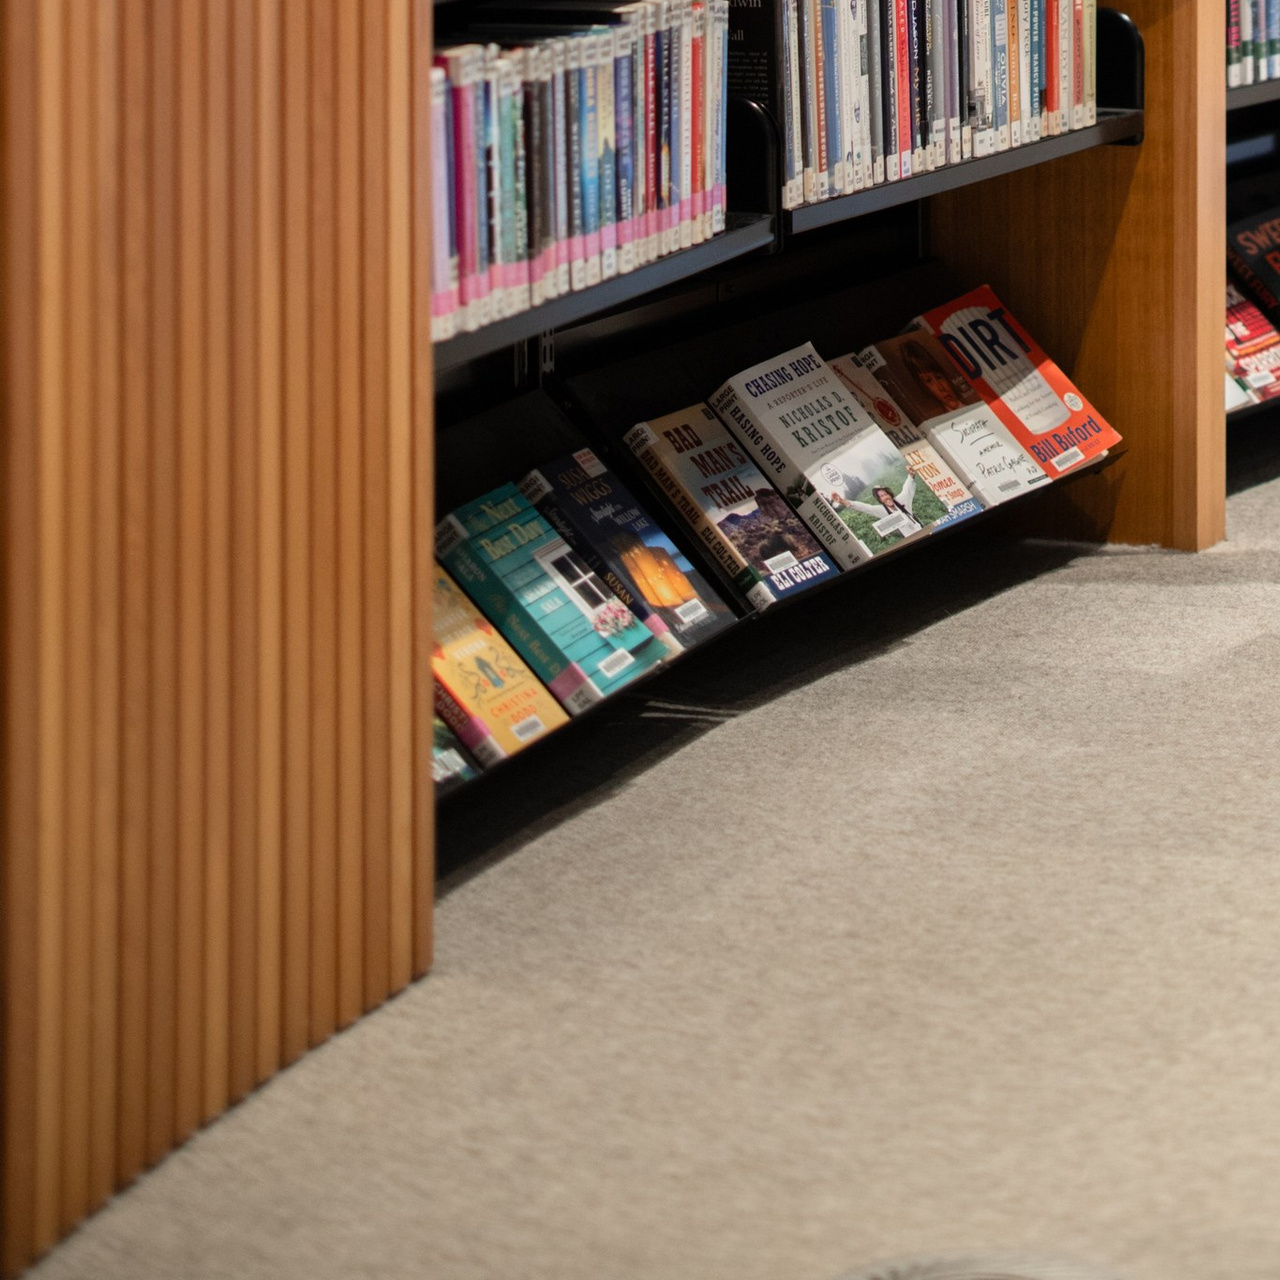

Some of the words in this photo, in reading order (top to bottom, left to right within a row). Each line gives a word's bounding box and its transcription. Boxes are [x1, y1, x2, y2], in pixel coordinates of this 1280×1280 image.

[912, 11, 920, 60] JASON
[820, 131, 828, 171] BROOKS
[938, 306, 1033, 381] DIRT
[744, 365, 793, 399] CHASING
[793, 353, 822, 378] HOPE
[766, 402, 774, 410] A
[773, 383, 813, 407] REPORTER'S
[813, 376, 830, 389] LIFE
[712, 384, 734, 409] LARGE
[719, 393, 739, 414] PRINT
[779, 395, 830, 428] NICHOLAS
[830, 390, 845, 404] D.
[663, 423, 704, 455] BAD
[730, 405, 765, 446] HASING
[760, 443, 786, 474] HOPE
[791, 405, 859, 449] KRISTOF
[1031, 440, 1060, 464] Bill
[1055, 415, 1103, 452] Buford
[690, 442, 747, 479] MAN'S
[917, 462, 941, 481] TON
[571, 478, 614, 506] WIGGS
[701, 475, 756, 510] TRAIL
[613, 506, 642, 527] WILLOW
[632, 517, 650, 532] LAKE
[640, 449, 657, 471] BAD
[654, 468, 680, 498] MAN'S
[677, 493, 700, 526] TRAIL
[700, 526, 713, 544] ELI
[710, 539, 741, 576] COLTER
[812, 495, 845, 537] NICHOLAS
[948, 501, 977, 520] SMARSH
[808, 512, 837, 547] KRISTOF
[604, 571, 635, 606] SUSAN
[770, 570, 791, 591] ELI
[789, 555, 830, 585] COLTER
